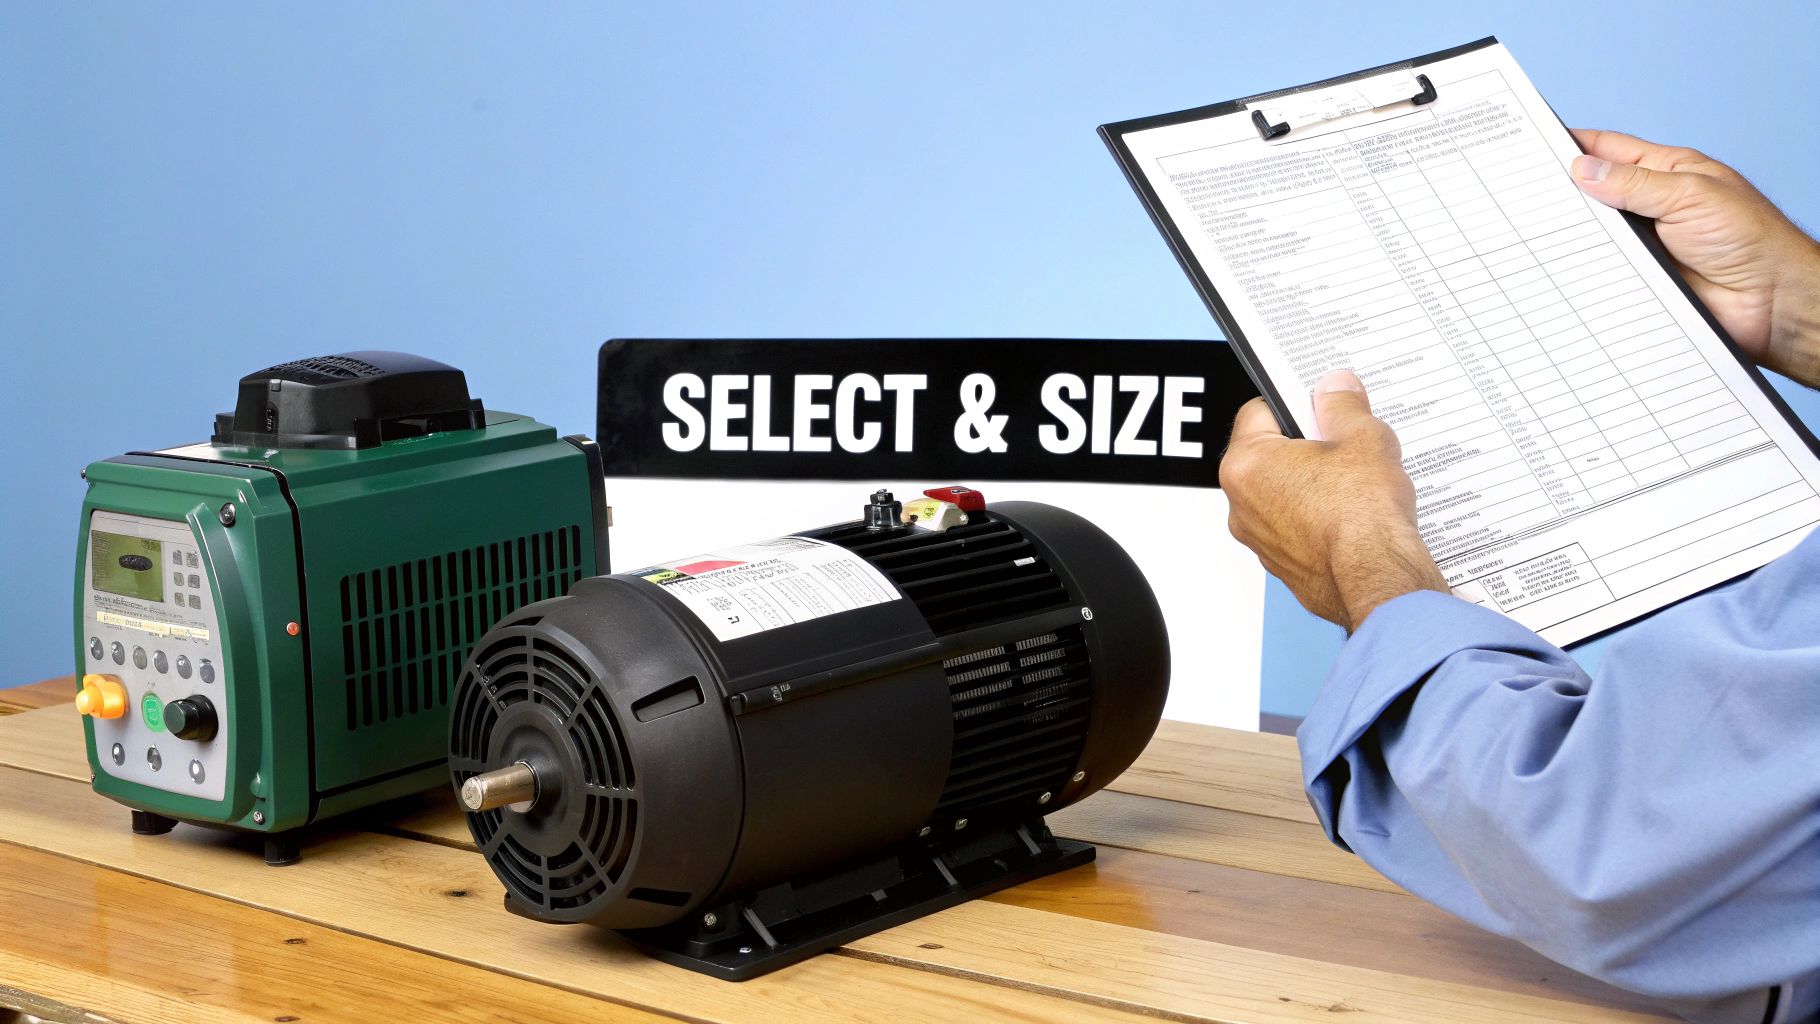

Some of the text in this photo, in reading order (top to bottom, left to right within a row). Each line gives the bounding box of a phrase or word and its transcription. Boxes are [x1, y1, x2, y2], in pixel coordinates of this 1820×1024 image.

[661, 372, 1205, 458] SELECT & SIZE
